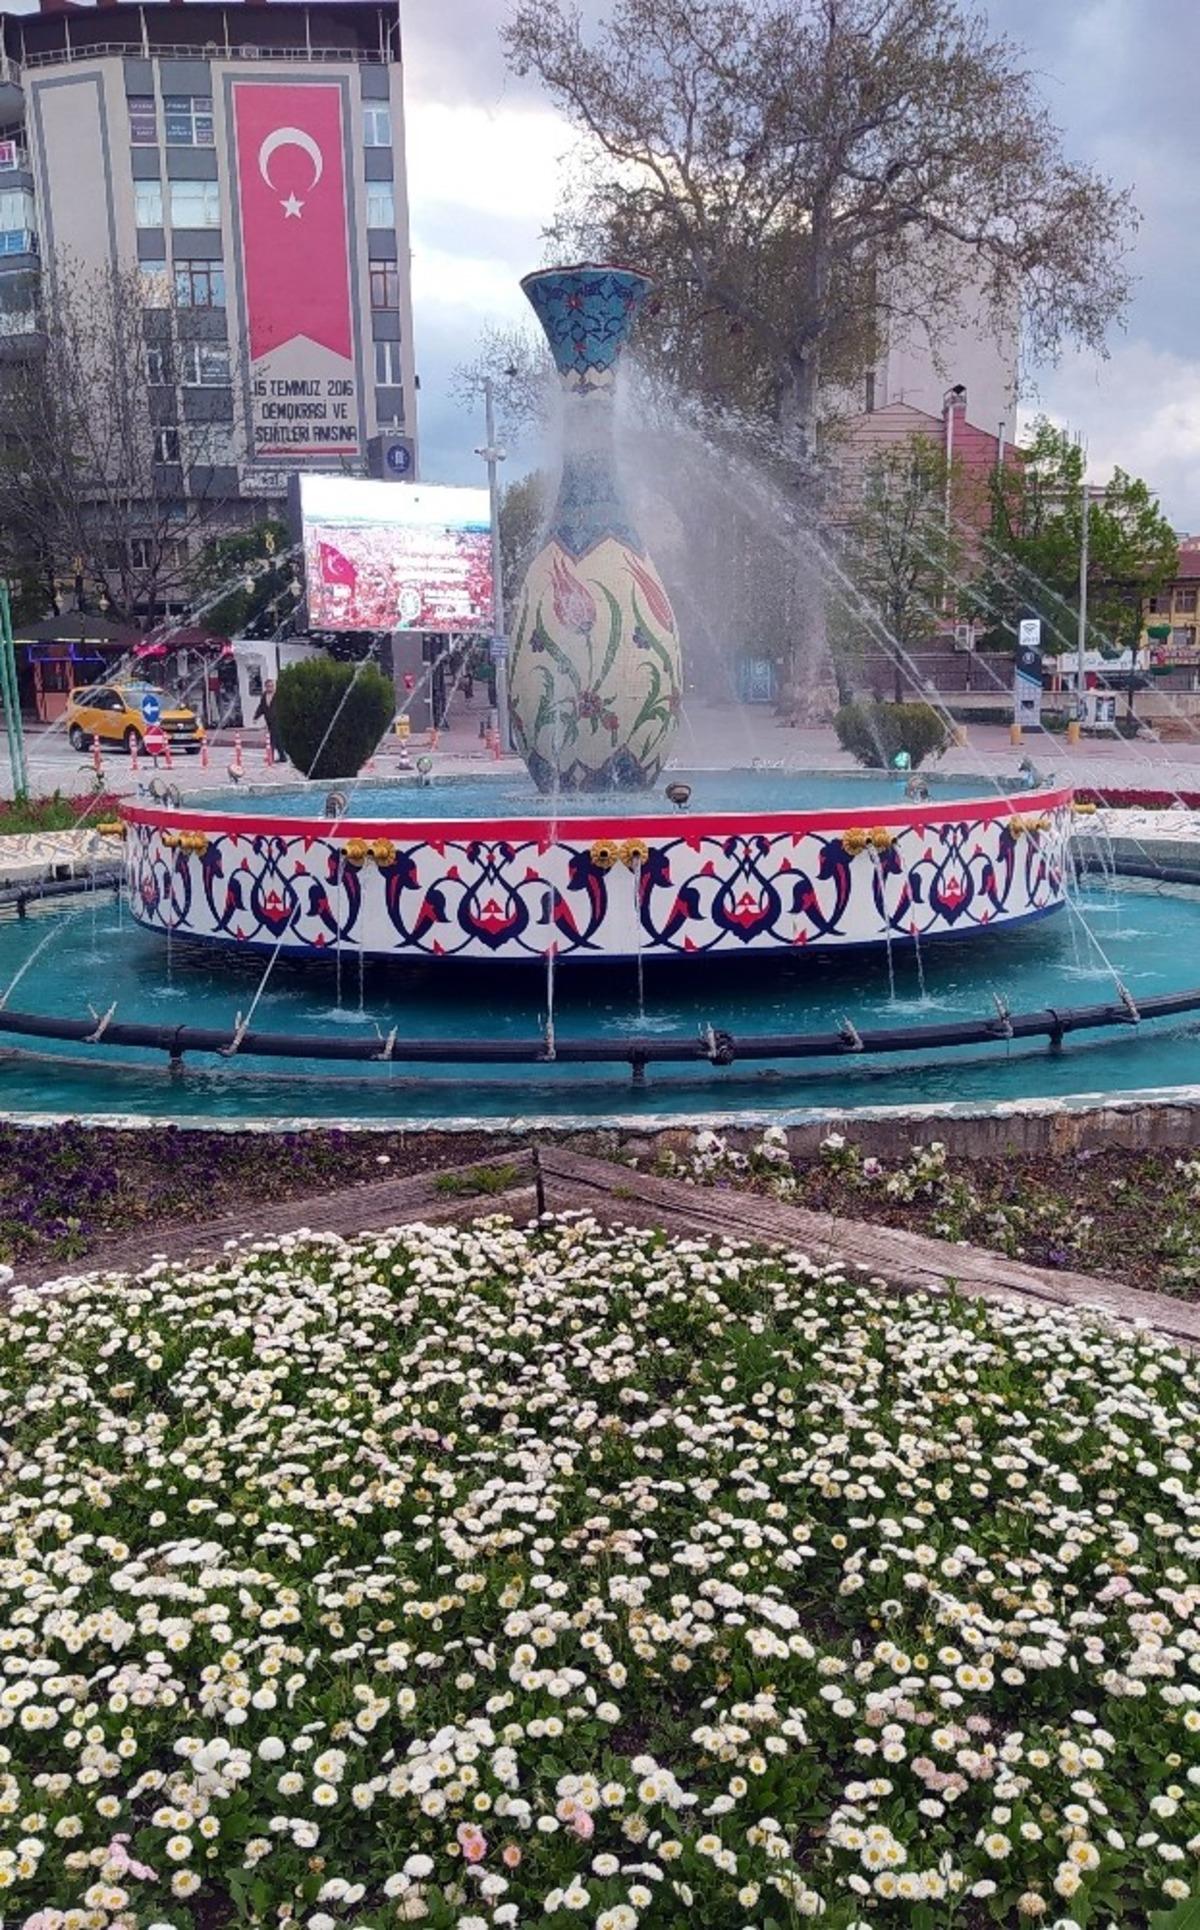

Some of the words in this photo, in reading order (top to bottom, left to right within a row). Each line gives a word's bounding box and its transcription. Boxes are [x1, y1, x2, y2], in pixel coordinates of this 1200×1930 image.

[254, 380, 267, 396] 15
[271, 380, 321, 396] TEMMUZ
[327, 380, 354, 396] 2016
[332, 403, 348, 419] VE
